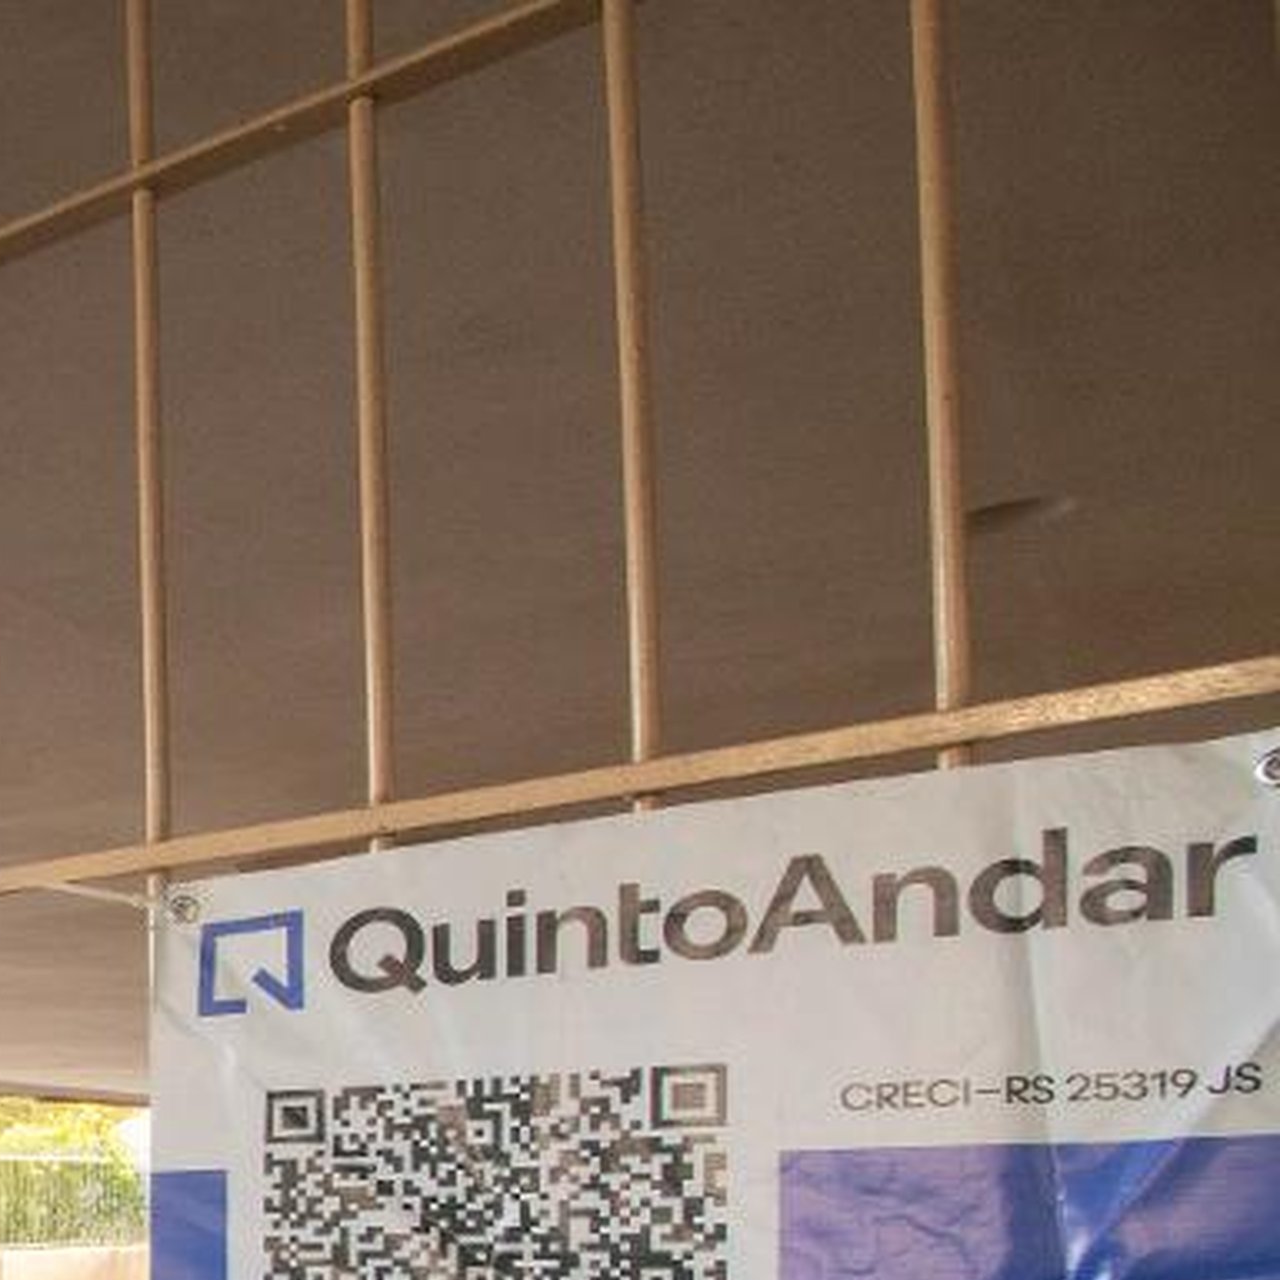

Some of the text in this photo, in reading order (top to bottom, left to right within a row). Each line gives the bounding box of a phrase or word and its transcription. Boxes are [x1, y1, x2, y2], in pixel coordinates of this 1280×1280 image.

[328, 827, 1257, 995] QuintoAndar
[840, 1061, 1263, 1110] CRECI-RS 25319 JS
